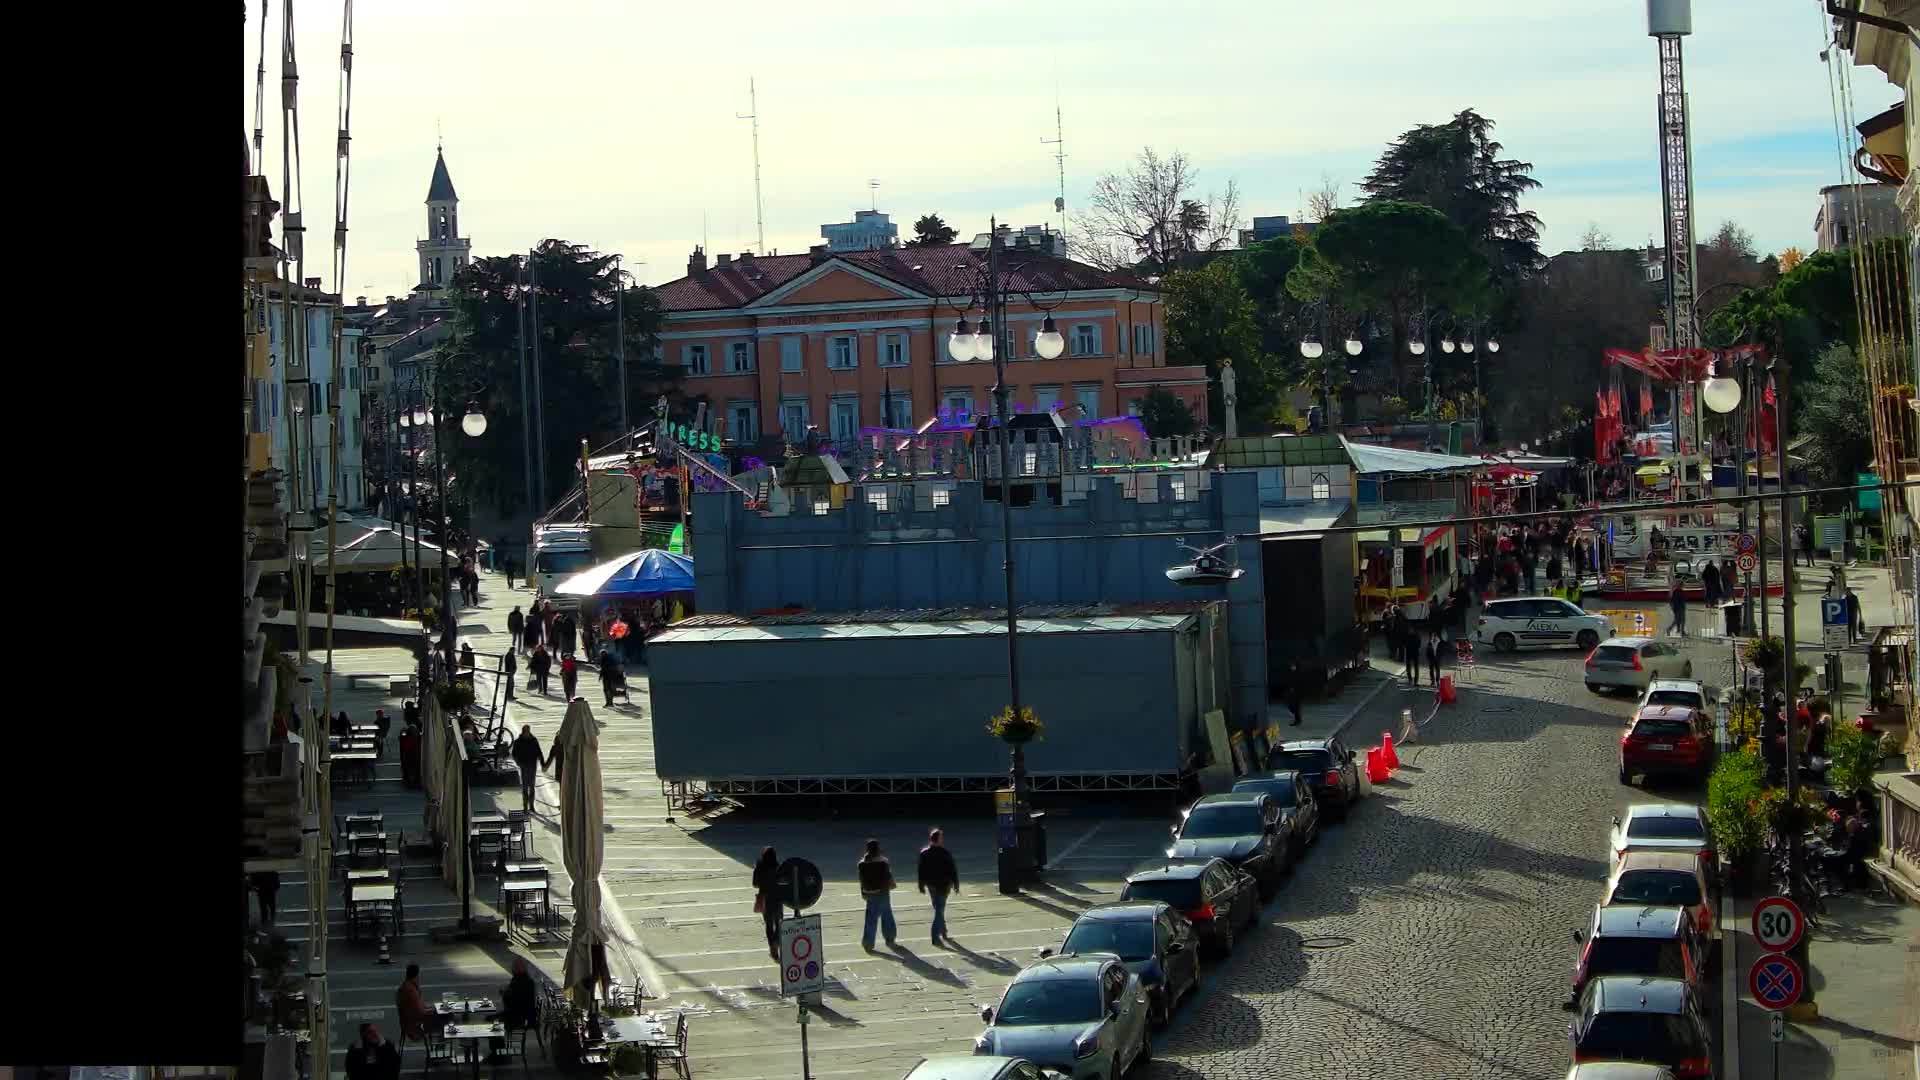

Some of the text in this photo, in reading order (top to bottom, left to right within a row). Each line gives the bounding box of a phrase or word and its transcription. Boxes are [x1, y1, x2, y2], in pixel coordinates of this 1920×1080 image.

[1742, 556, 1752, 567] 20
[1826, 602, 1842, 622] P
[1528, 622, 1560, 631] ALEXA
[1760, 911, 1792, 938] 30
